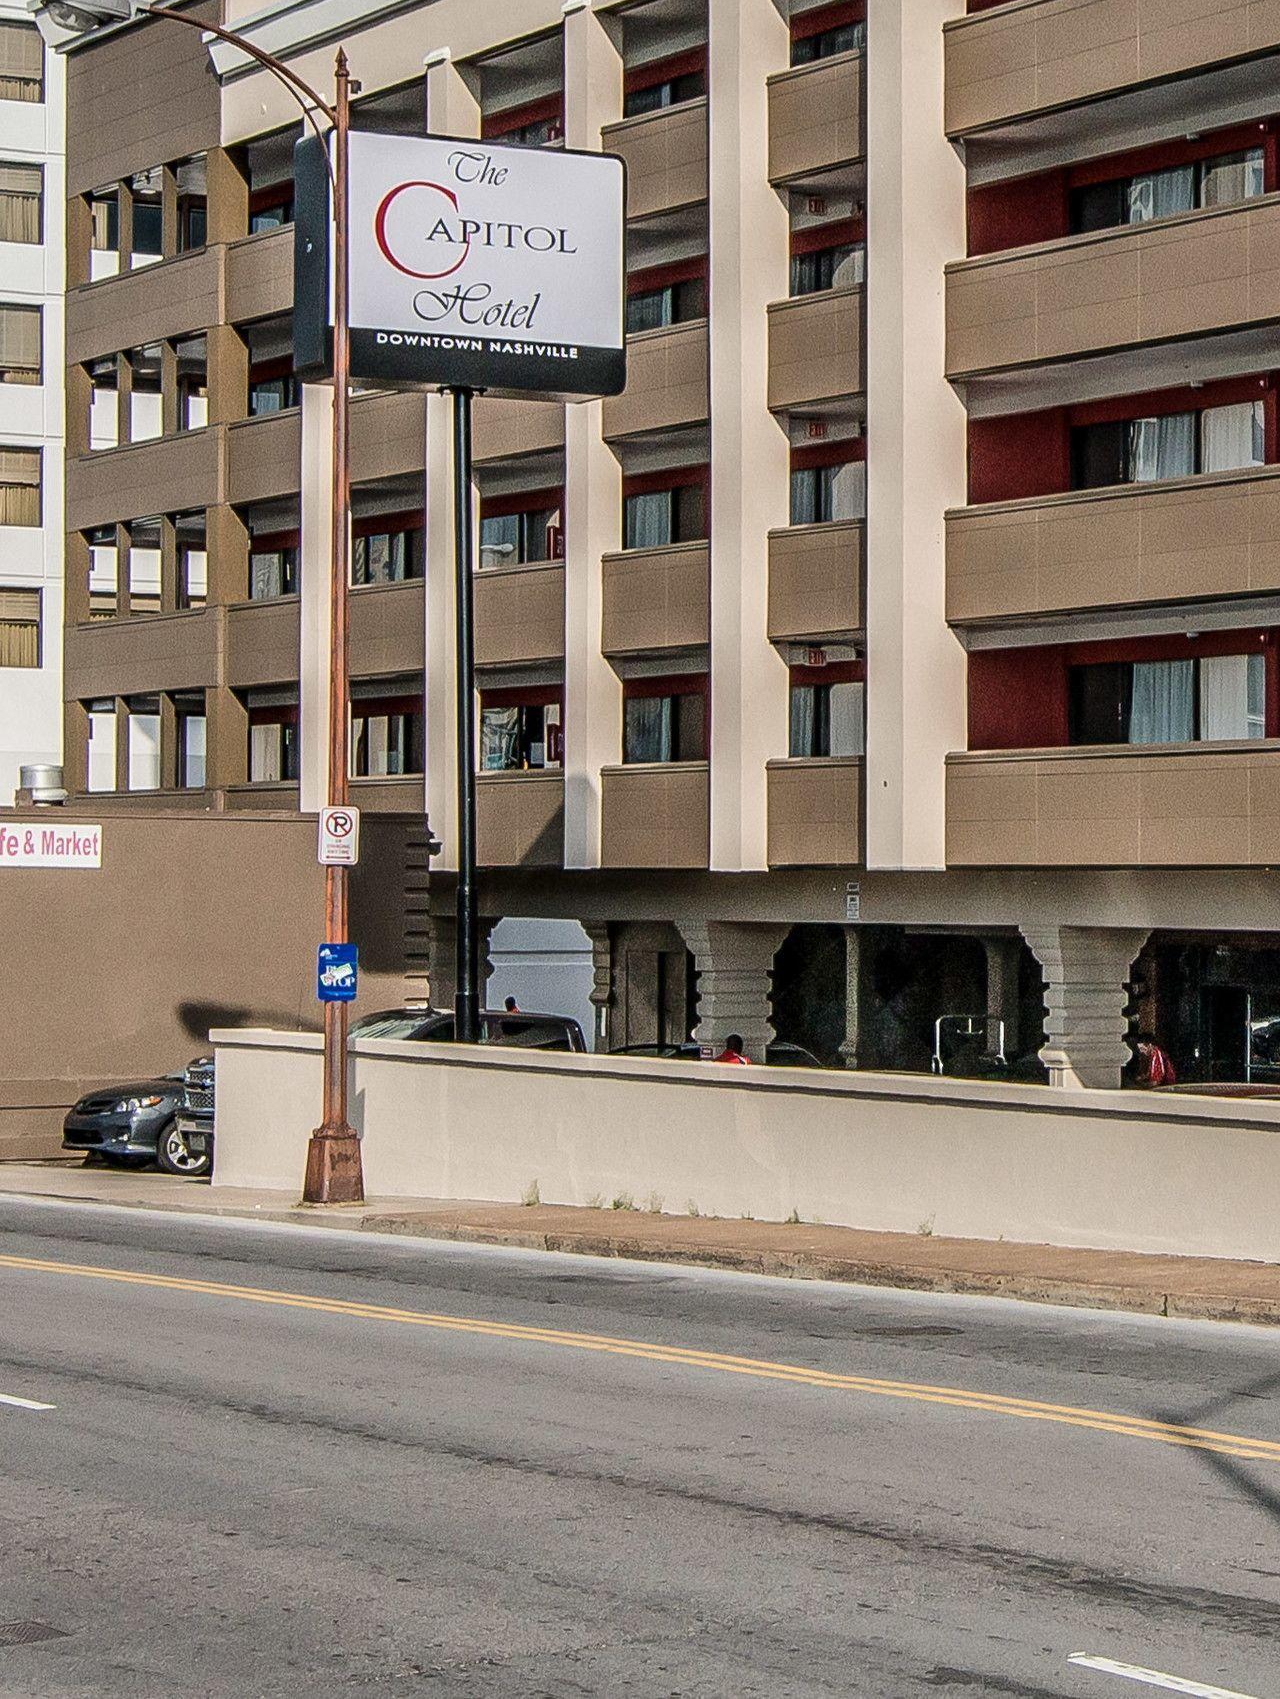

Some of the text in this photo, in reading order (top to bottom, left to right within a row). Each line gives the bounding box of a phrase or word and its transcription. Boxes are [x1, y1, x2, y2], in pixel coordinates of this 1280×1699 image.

[447, 151, 509, 186] The
[375, 181, 578, 279] CAPITOL
[412, 283, 541, 329] Hotel
[376, 332, 579, 359] DOWNTOWN NASHVILLE
[23, 830, 35, 854] &
[41, 830, 98, 856] Market
